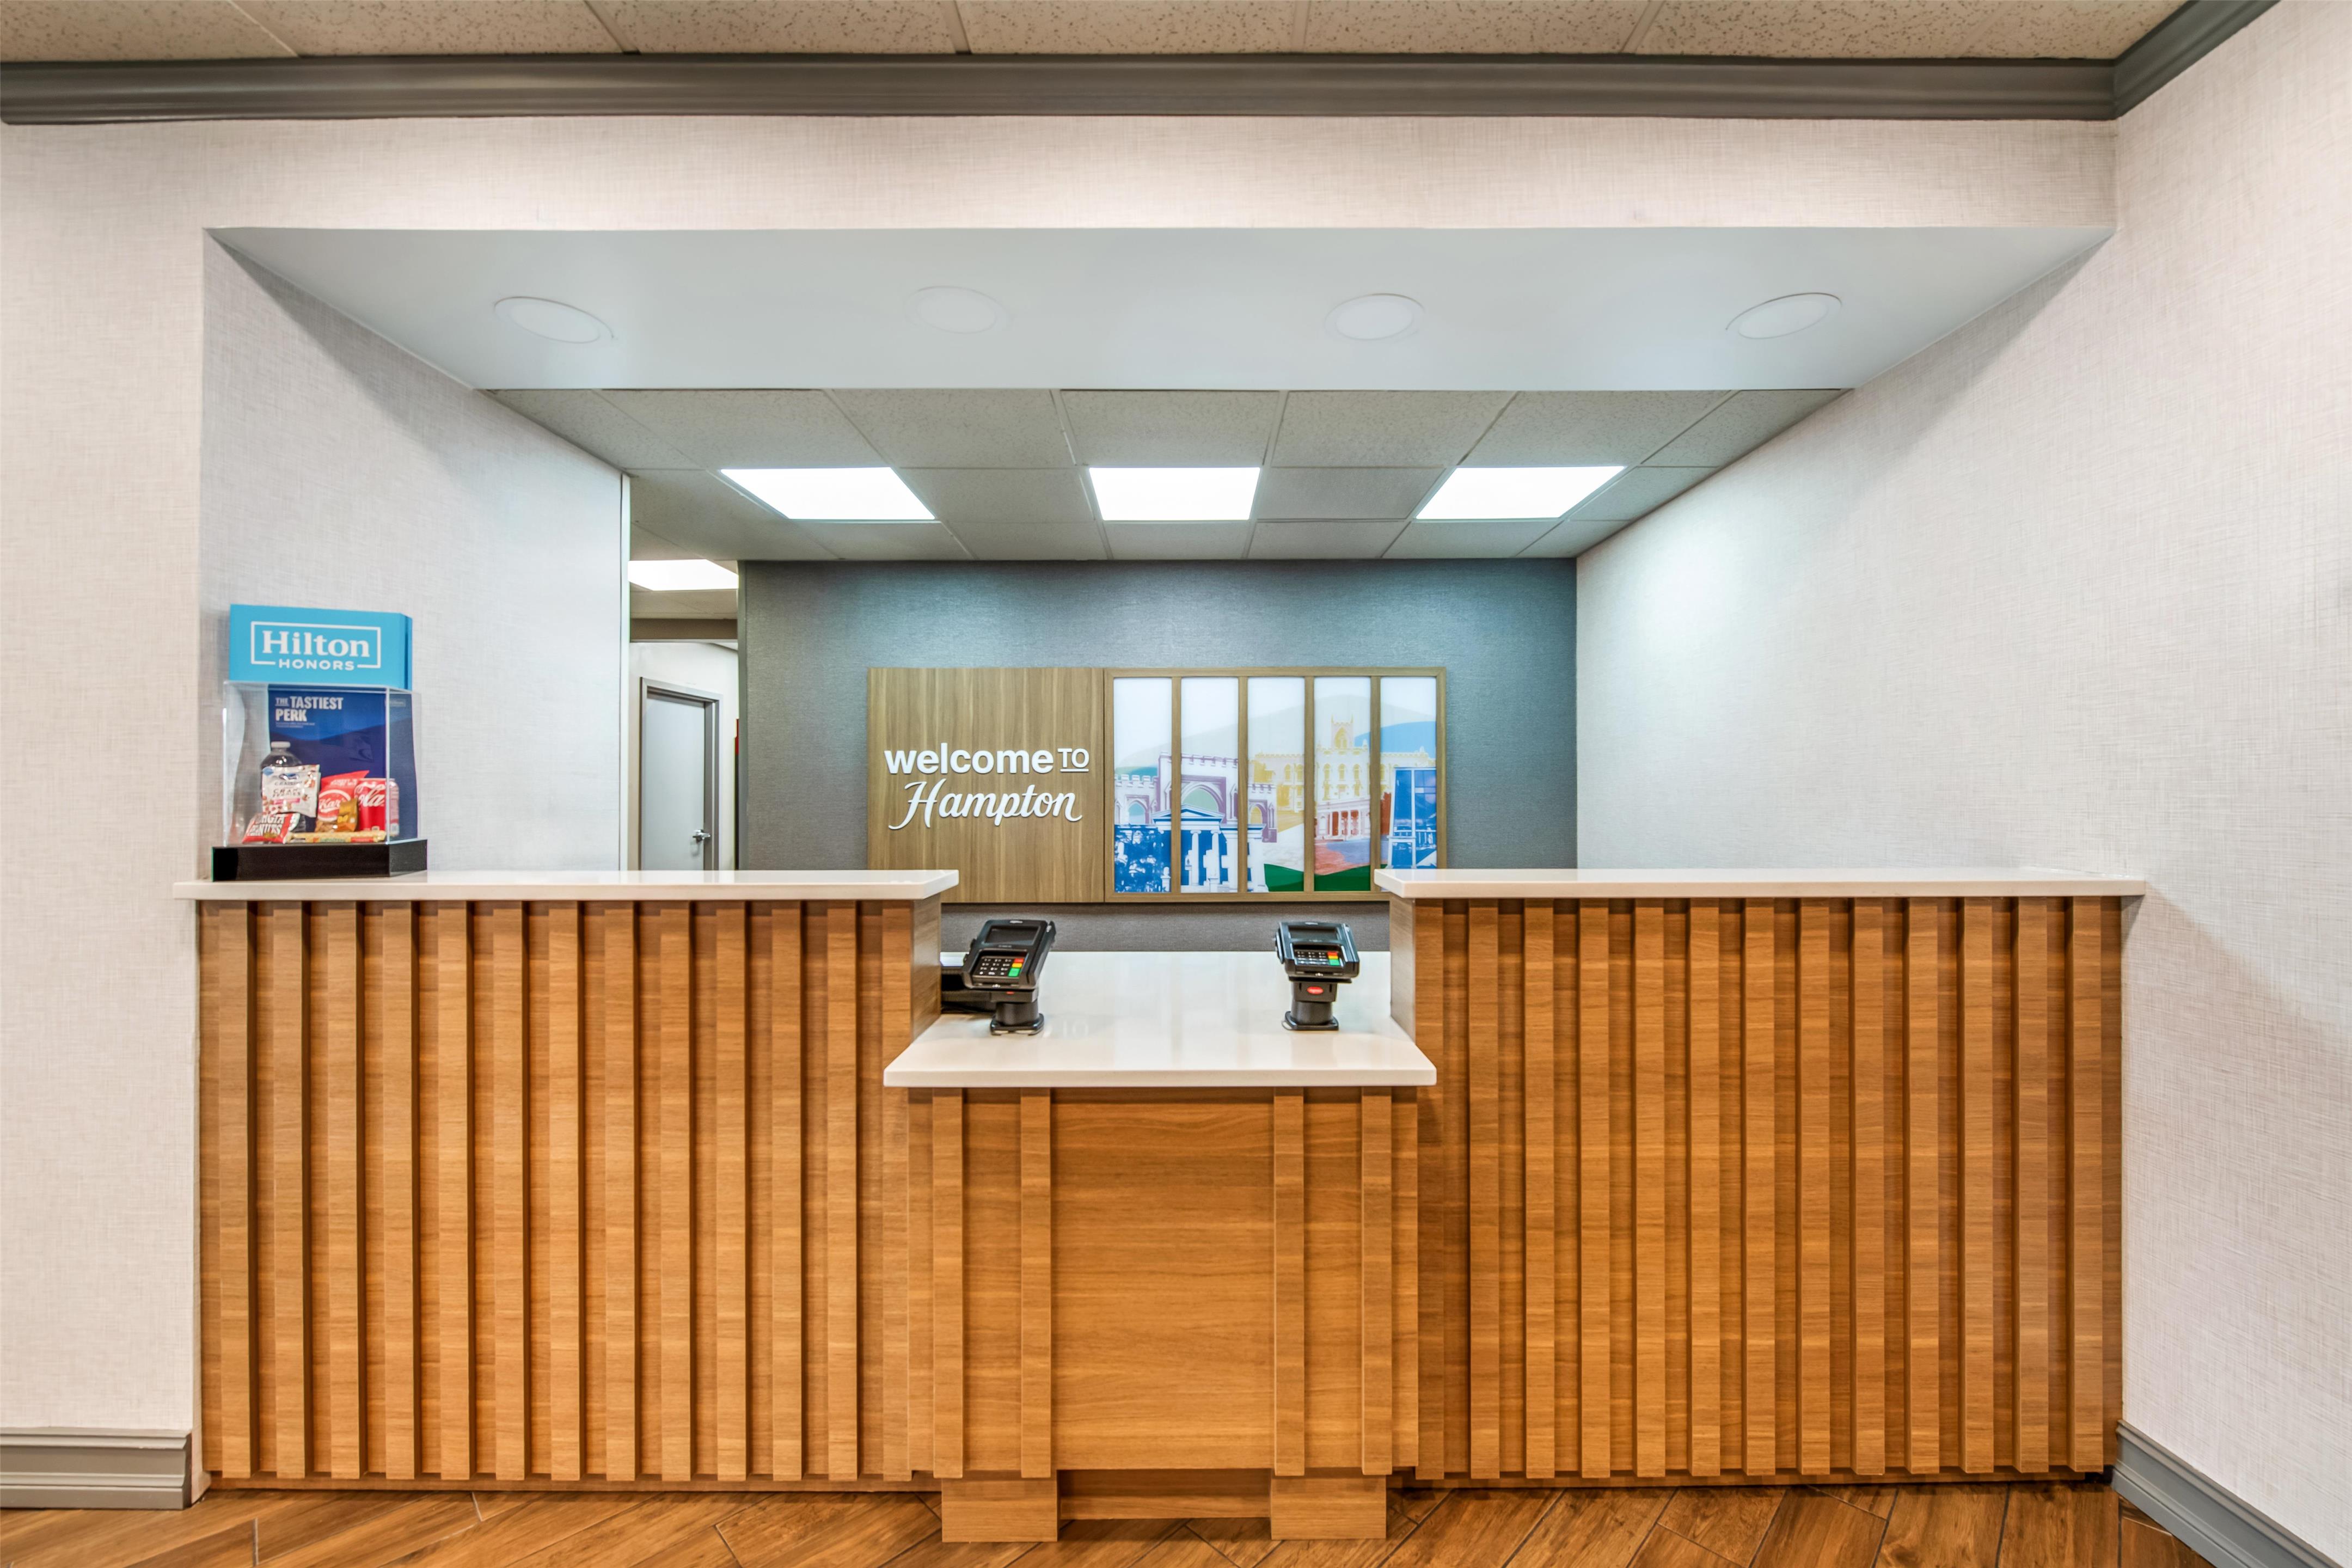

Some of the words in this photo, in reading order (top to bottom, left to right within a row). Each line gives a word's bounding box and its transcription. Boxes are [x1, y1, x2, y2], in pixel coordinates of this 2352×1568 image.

[262, 630, 370, 658] Hilton
[278, 659, 354, 671] HONORS
[275, 697, 289, 707] THE
[290, 696, 344, 710] TASTIEST
[275, 709, 307, 721] PERK
[884, 742, 1054, 774] welcome
[1057, 748, 1090, 772] TO
[888, 778, 1083, 830] Hampton
